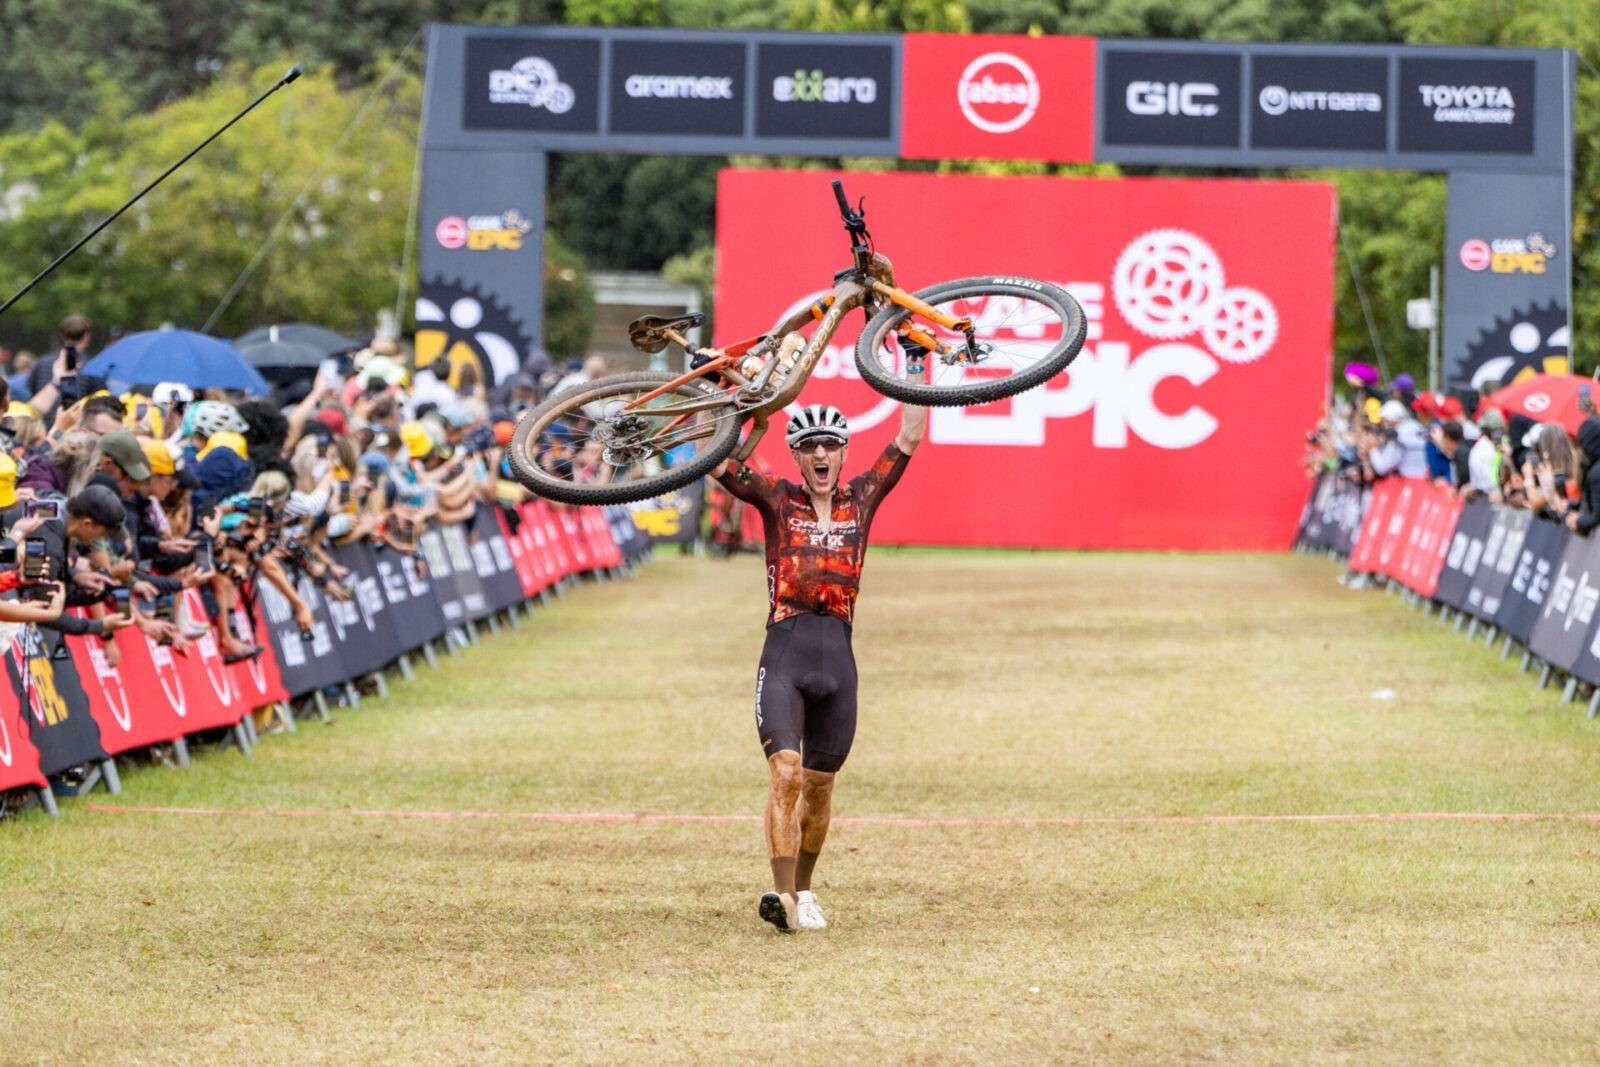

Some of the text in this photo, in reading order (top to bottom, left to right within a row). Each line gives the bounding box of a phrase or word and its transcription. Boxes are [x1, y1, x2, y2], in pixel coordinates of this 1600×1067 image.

[625, 75, 734, 99] aramex
[773, 69, 876, 103] exxaro
[967, 75, 1029, 104] absa
[1126, 81, 1219, 116] GIC
[1419, 85, 1515, 108] TOYOTA
[993, 278, 1042, 290] MAXXIS
[929, 339, 1220, 450] EPIC
[789, 517, 857, 529] OREA
